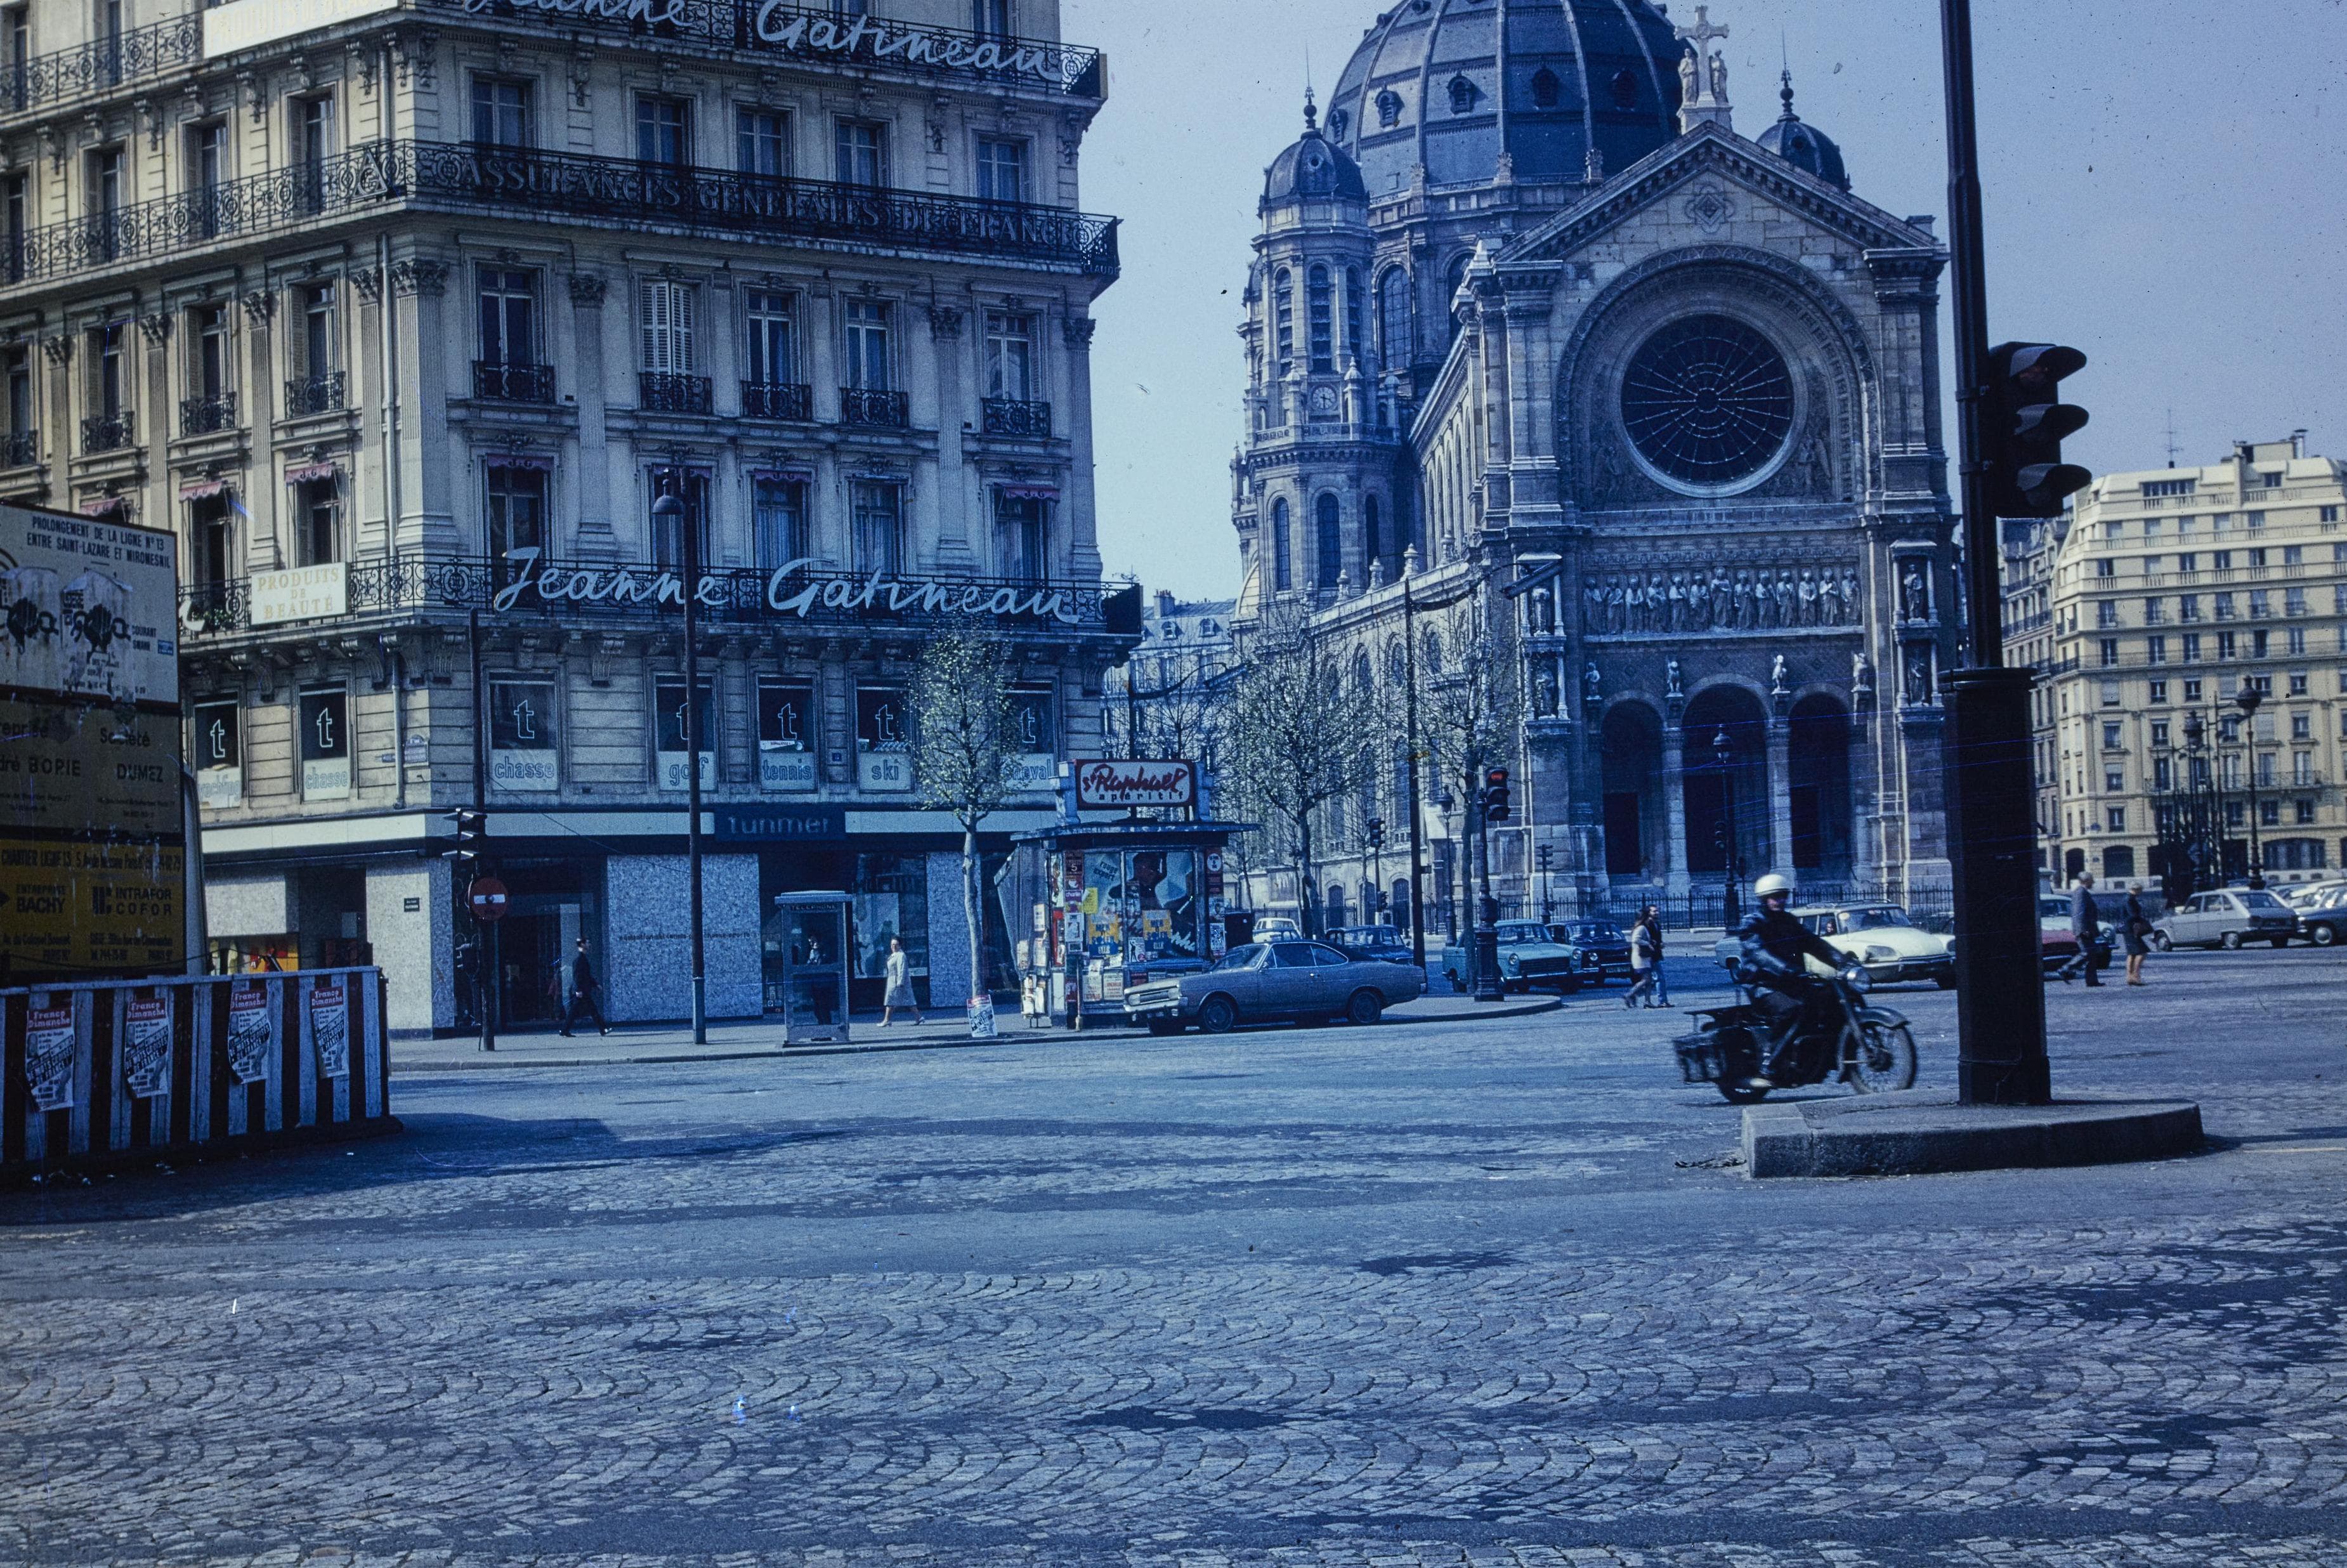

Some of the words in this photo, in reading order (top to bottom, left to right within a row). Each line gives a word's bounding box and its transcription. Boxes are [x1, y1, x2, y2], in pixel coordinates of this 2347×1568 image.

[32, 516, 89, 537] PROLONGEMENT
[94, 527, 104, 540] DE
[108, 530, 117, 543] LA
[121, 532, 142, 548] LIGNE
[156, 539, 164, 551] 13
[27, 533, 51, 546] ENTRE
[56, 537, 110, 558] SAINT-LAZARE
[114, 548, 122, 560] ET
[126, 550, 171, 569] MIROMESNIL
[258, 567, 340, 592] PRODUITS
[492, 546, 729, 613] Jeanne
[768, 557, 1080, 624] Gatineau
[290, 587, 306, 600] DE
[263, 595, 334, 620] BEAUTÉ
[317, 707, 333, 748] t
[513, 699, 534, 740] t
[777, 702, 797, 740] t
[875, 703, 894, 741] t
[1021, 707, 1036, 744] t
[210, 719, 225, 759] t
[117, 762, 164, 783] DUMEZ
[305, 766, 348, 790] chasse
[494, 755, 554, 781] chasse
[669, 755, 709, 786] gof
[762, 757, 813, 781] tennis
[872, 761, 899, 781] ski
[1099, 790, 1183, 802] apéritif
[728, 816, 828, 834] tunmer
[1071, 863, 1078, 872] 5
[16, 897, 66, 914] BACHY
[115, 887, 173, 900] INTRAFOR
[115, 902, 173, 915] COFOR
[131, 1002, 160, 1010] France
[235, 992, 261, 1001] France
[315, 990, 339, 998] France
[34, 1010, 66, 1020] France
